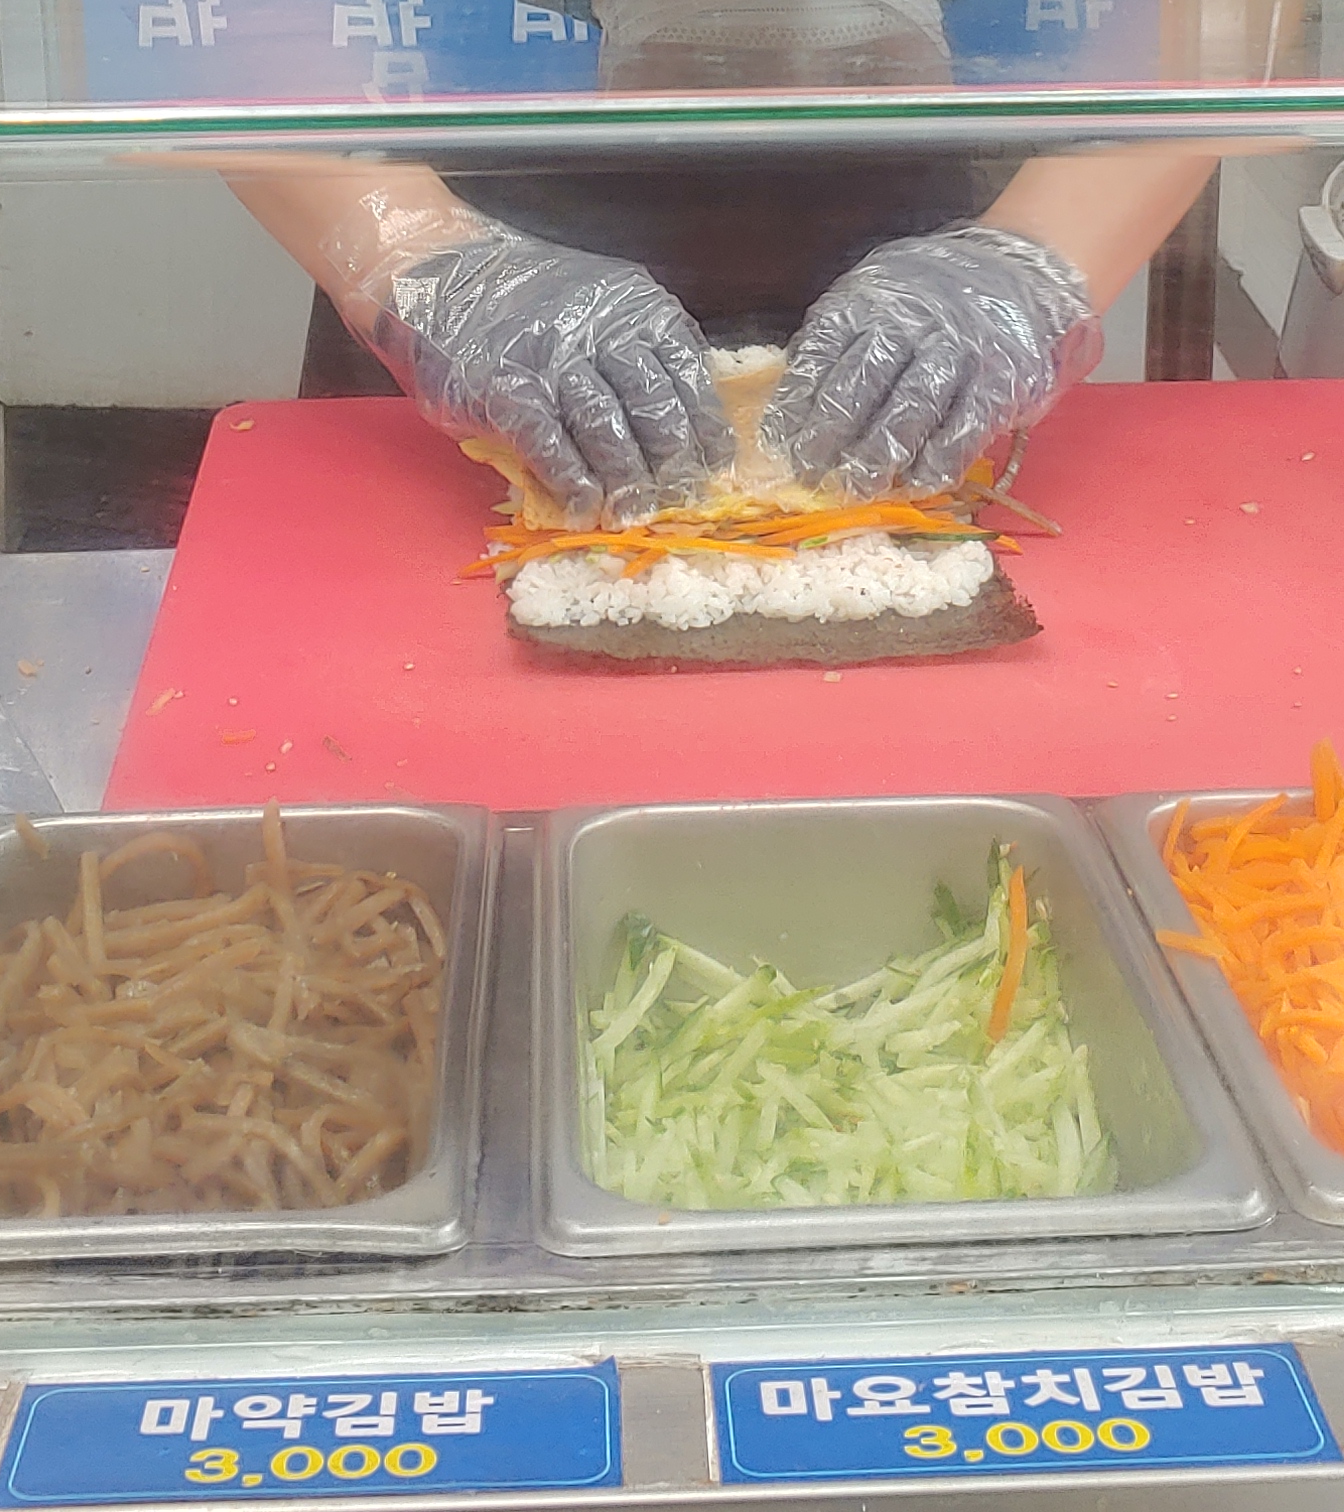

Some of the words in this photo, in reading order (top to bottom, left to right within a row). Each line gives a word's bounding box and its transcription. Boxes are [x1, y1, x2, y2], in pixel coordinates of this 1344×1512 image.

[139, 1389, 494, 1442] 마약김밥
[759, 1361, 1265, 1422] 마요참치김밥
[184, 1442, 438, 1487] 3,000
[903, 1418, 1151, 1463] 3,000
